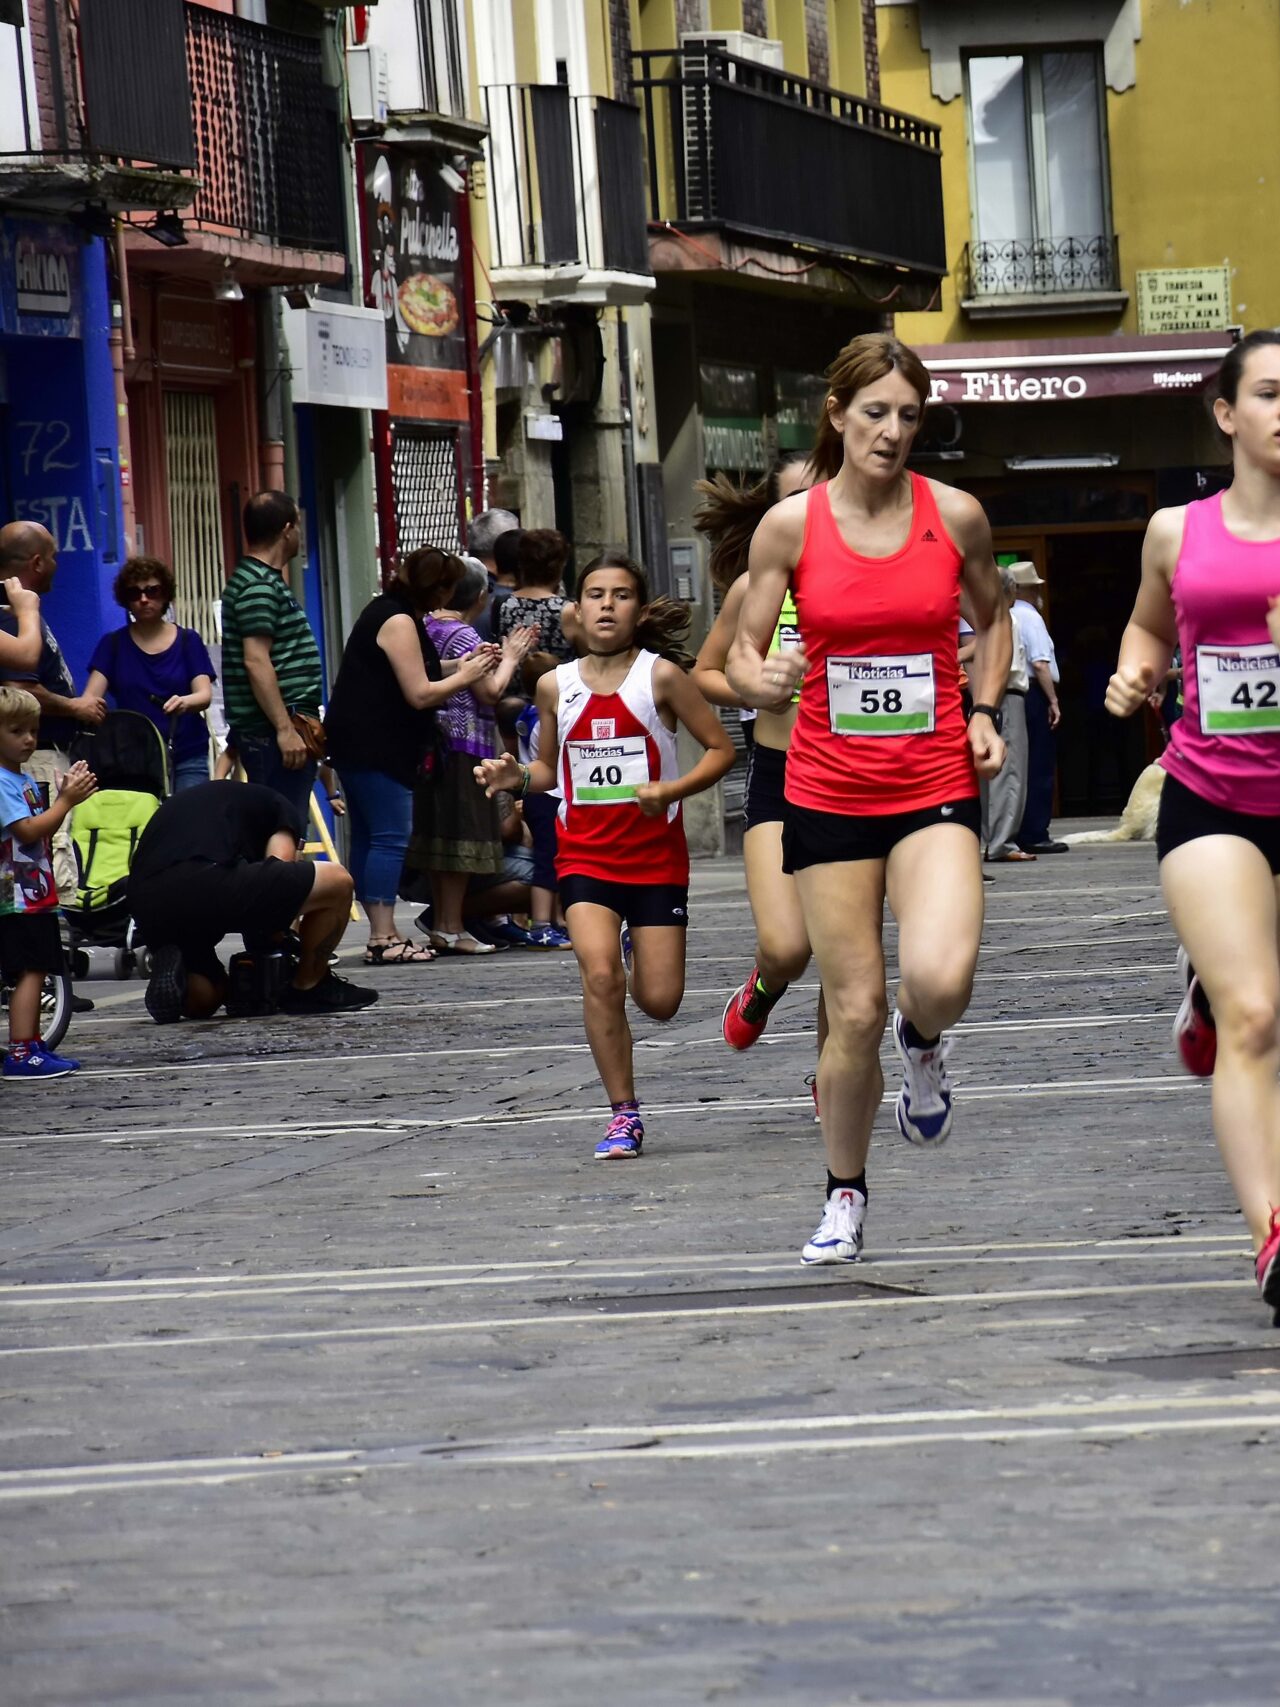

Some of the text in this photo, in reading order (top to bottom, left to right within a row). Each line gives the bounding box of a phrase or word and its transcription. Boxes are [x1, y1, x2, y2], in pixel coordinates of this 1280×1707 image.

[1165, 281, 1203, 291] TRAVESIA
[1152, 292, 1218, 304] ESPOZ Y MINA
[1150, 311, 1178, 320] ESPOZ
[1196, 308, 1219, 318] MINA
[961, 371, 1087, 401] Fitero
[16, 420, 80, 476] 72
[1219, 657, 1278, 671] Noticias
[850, 667, 904, 680] Noticias
[860, 689, 903, 714] 58
[1230, 680, 1279, 709] 42
[580, 747, 623, 759] Noticias
[589, 764, 623, 786] 40
